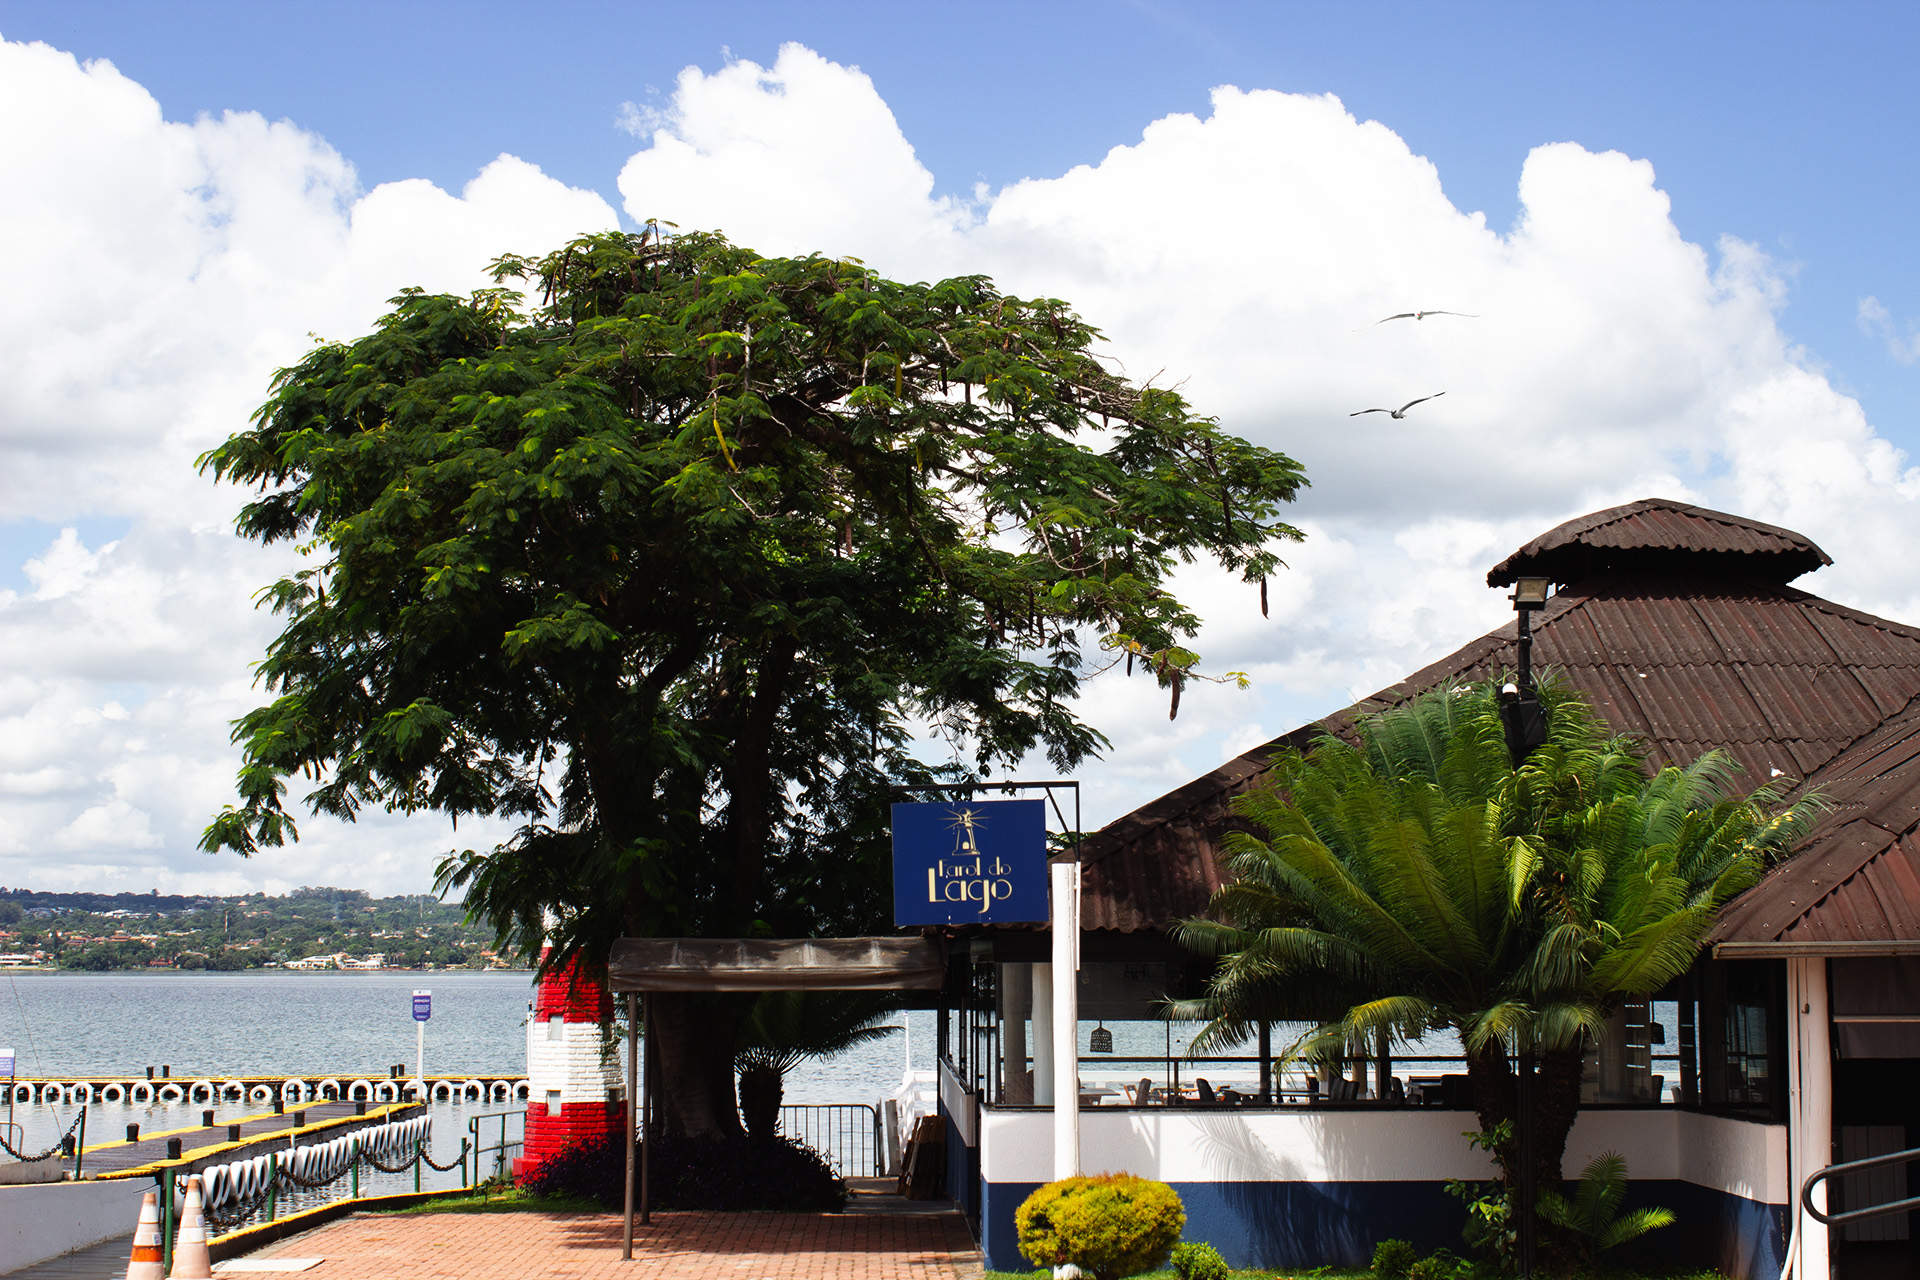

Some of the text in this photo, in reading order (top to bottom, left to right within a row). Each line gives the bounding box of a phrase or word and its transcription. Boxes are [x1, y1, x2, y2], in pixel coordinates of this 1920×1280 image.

[938, 856, 1012, 877] Farol do
[928, 867, 1013, 914] Lago
